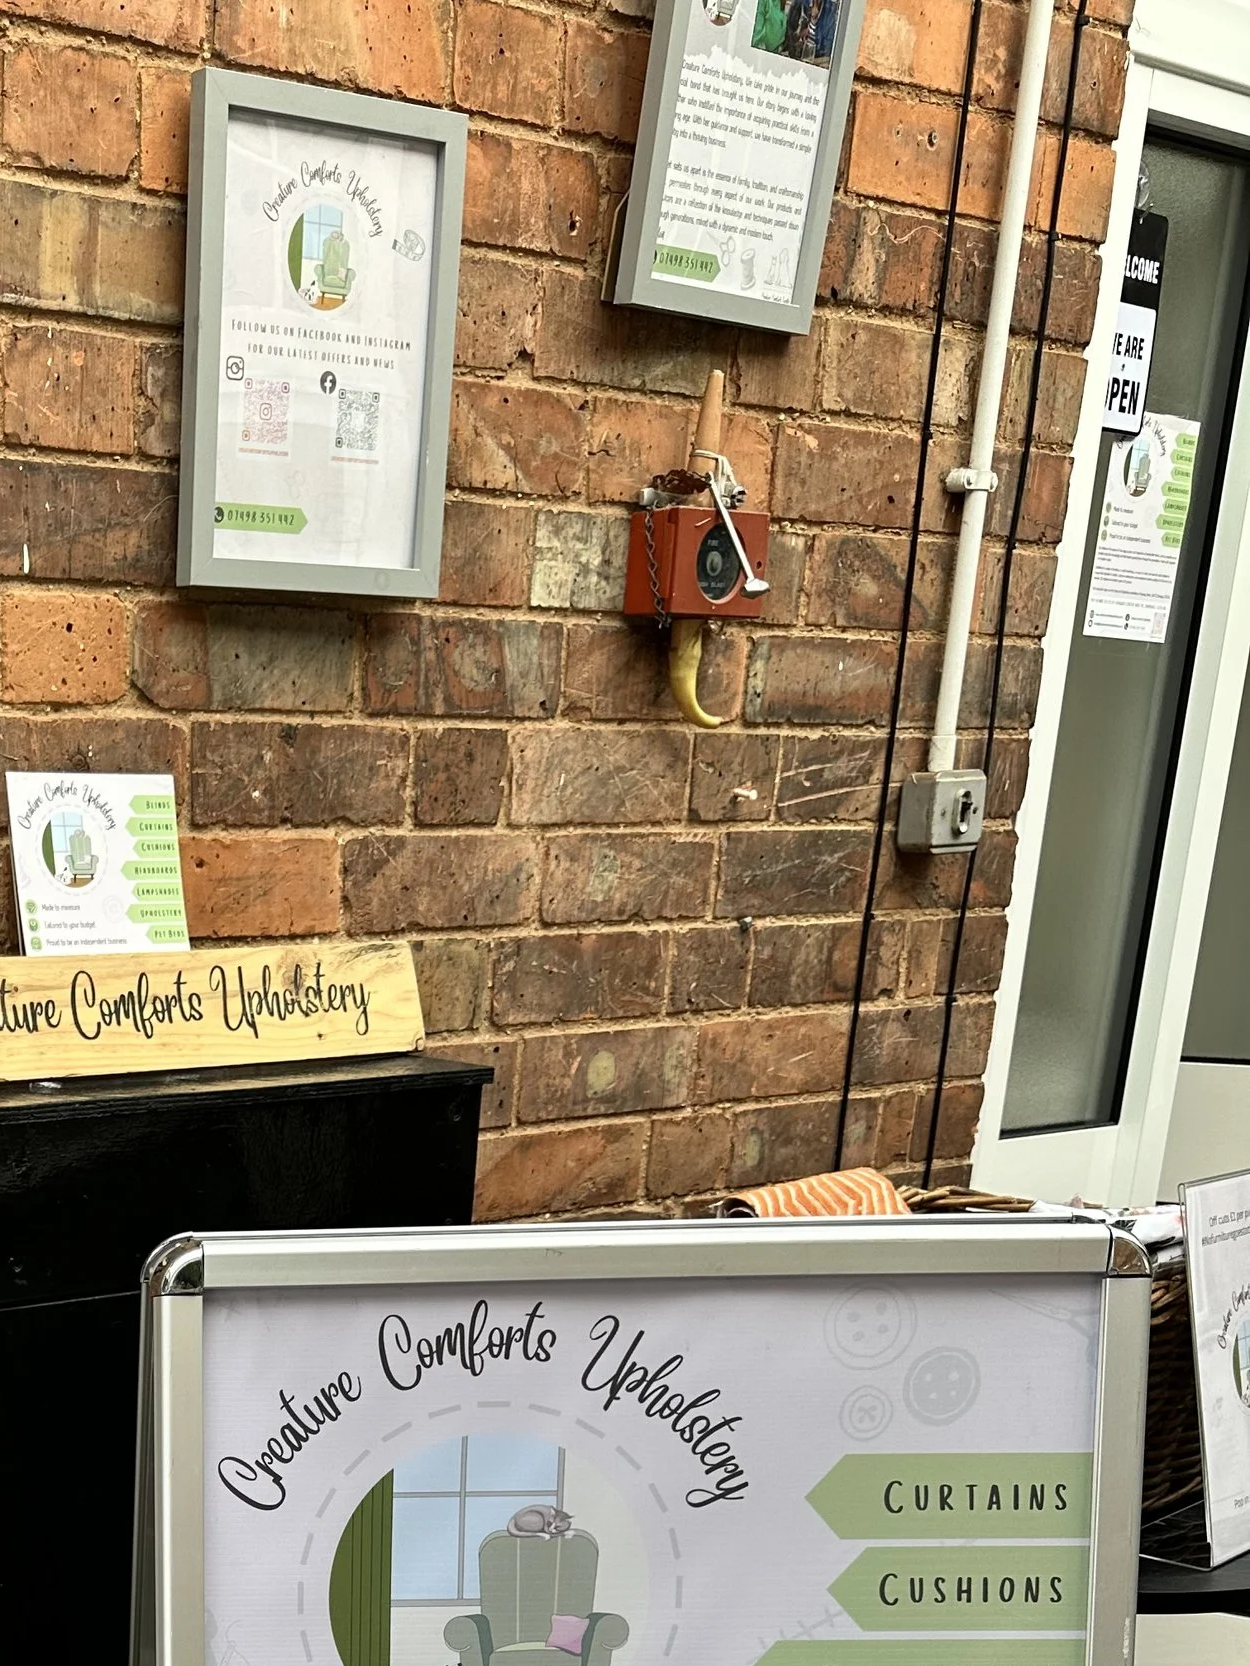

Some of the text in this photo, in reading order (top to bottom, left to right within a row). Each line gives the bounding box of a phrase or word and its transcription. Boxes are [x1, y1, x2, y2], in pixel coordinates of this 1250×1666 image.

[262, 160, 383, 238] Creature Comforts Upholstery
[659, 255, 713, 273] 07498 351 442
[1124, 255, 1160, 284] LCOME
[231, 319, 411, 351] FOLLOW US ON FACEBOOK AND INSTAGRAM
[1124, 336, 1145, 360] ARE
[248, 343, 395, 369] FOR OUR LATEST OFFERS AND NEWS
[1105, 377, 1140, 415] PEN
[228, 510, 294, 525] 07498 351 442
[17, 780, 116, 830] Creature Comforts Upholstery
[70, 970, 203, 1041] Comforts
[209, 961, 370, 1038] Upholstery
[217, 1300, 751, 1511] Creature Comforts Upholstery
[883, 1480, 1068, 1514] CURTAINS
[878, 1572, 1063, 1606] CUSHIONS
